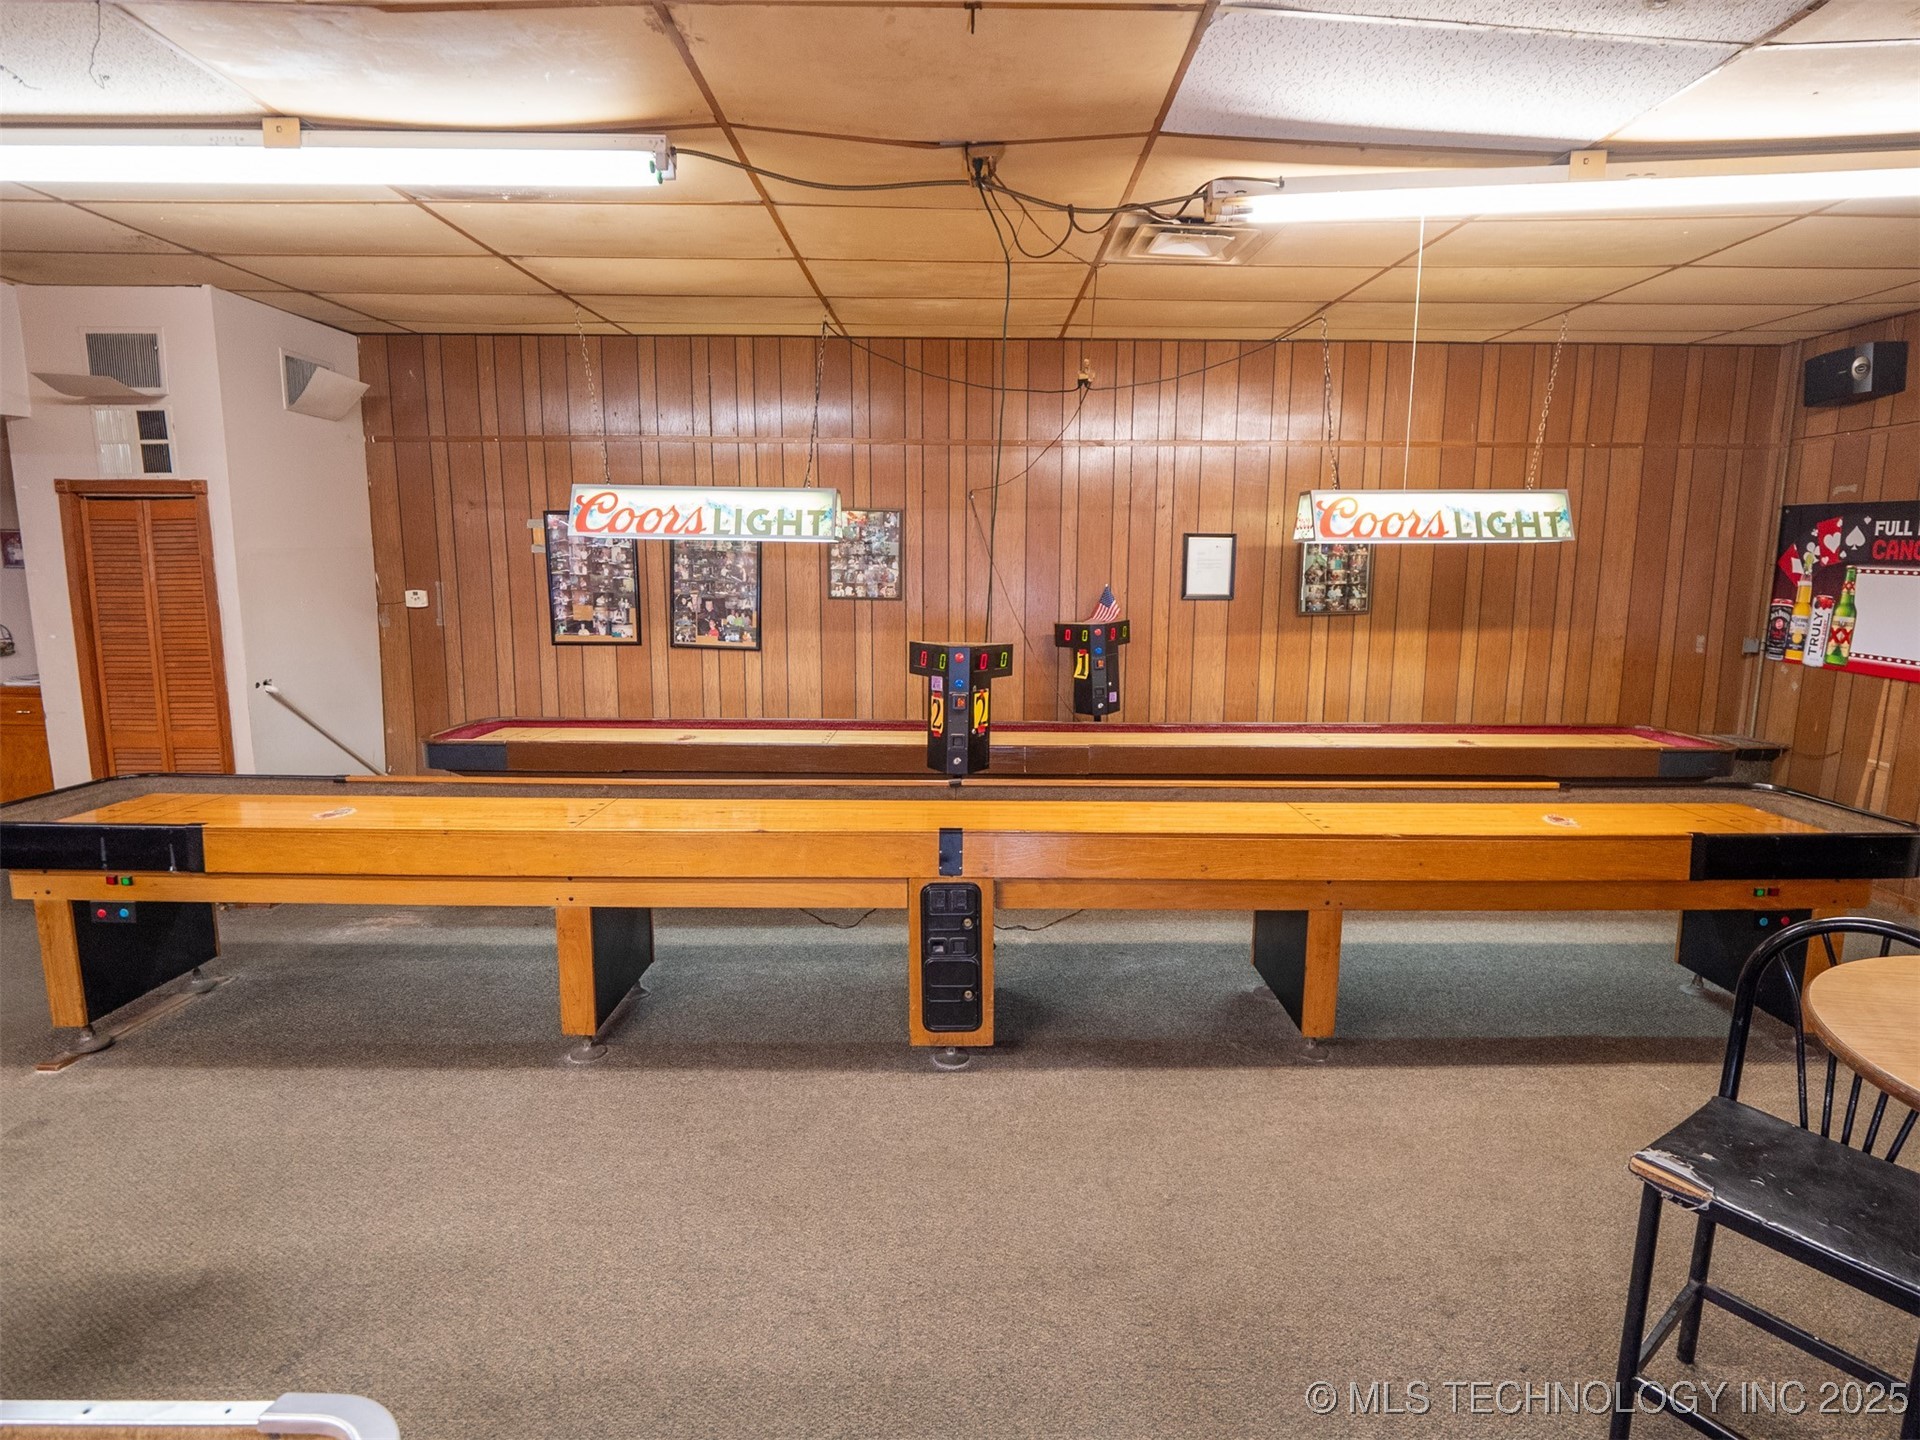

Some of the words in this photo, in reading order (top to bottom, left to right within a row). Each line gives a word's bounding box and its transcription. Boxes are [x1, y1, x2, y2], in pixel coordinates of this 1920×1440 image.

[575, 492, 707, 535] Coors
[713, 507, 827, 537] LIGHT
[1315, 497, 1448, 538] Coors
[1454, 510, 1563, 539] LIGHT
[1874, 520, 1913, 537] FULL
[1081, 629, 1089, 642] 0
[1807, 612, 1824, 656] TRULY
[920, 650, 928, 667] 0
[939, 653, 947, 670] 0
[980, 653, 989, 670] 0
[1000, 651, 1008, 668] 0
[1077, 655, 1087, 677] 1
[932, 699, 943, 729] 2
[976, 695, 989, 726] 2
